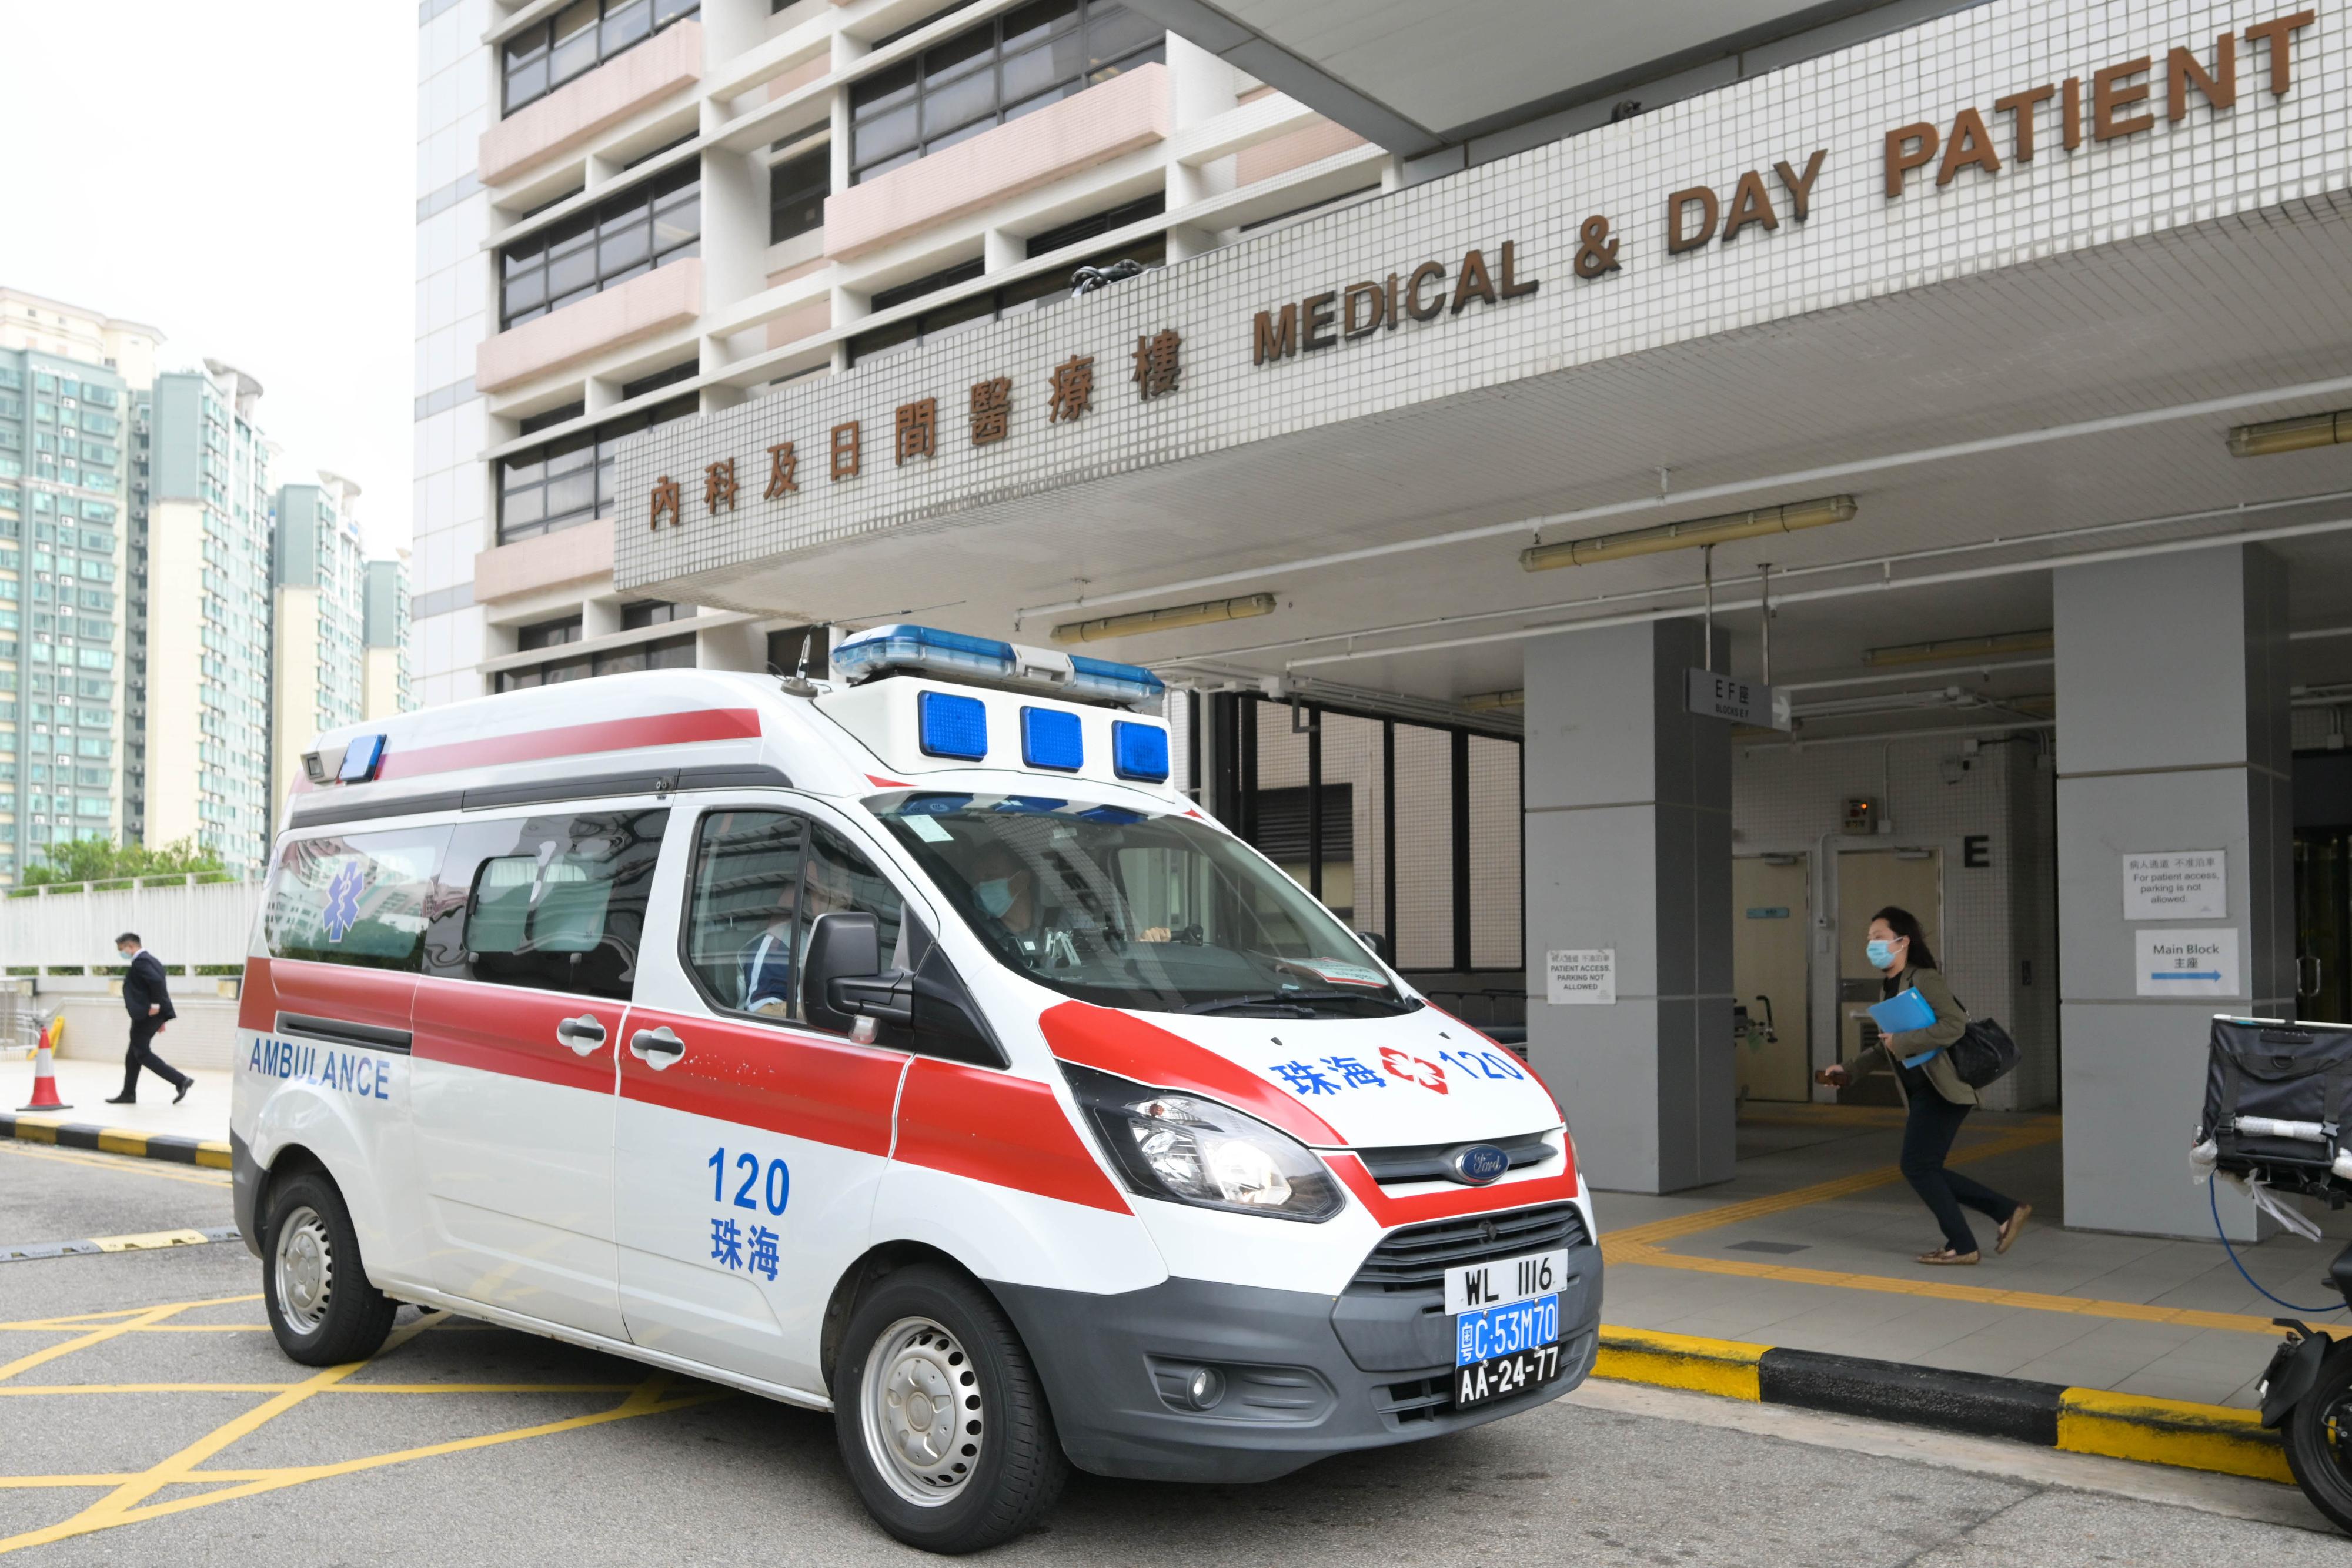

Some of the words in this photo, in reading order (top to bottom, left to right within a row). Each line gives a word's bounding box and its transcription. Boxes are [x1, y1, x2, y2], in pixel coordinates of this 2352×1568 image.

[1253, 240, 1539, 366] MEDICAL
[1573, 215, 1622, 280] &
[1668, 149, 1828, 256] DAY
[1885, 9, 2315, 198] PATIENT
[1965, 835, 1990, 867] E
[2140, 884, 2173, 894] parking
[2187, 883, 2201, 891] not
[2151, 872, 2181, 882] patient
[2153, 944, 2183, 954] Main
[2187, 944, 2219, 954] Block
[2174, 957, 2198, 969] 主座
[249, 1038, 390, 1100] AMBULANCE
[1270, 1056, 1387, 1095] 珠海
[1439, 1051, 1524, 1081] 120
[709, 1147, 789, 1216] 120
[1474, 1152, 1501, 1174] Ford
[711, 1218, 779, 1281] 珠海
[1465, 1268, 1499, 1306] WL
[1518, 1257, 1552, 1296] 1116
[1461, 1346, 1558, 1403] AA-24-77
